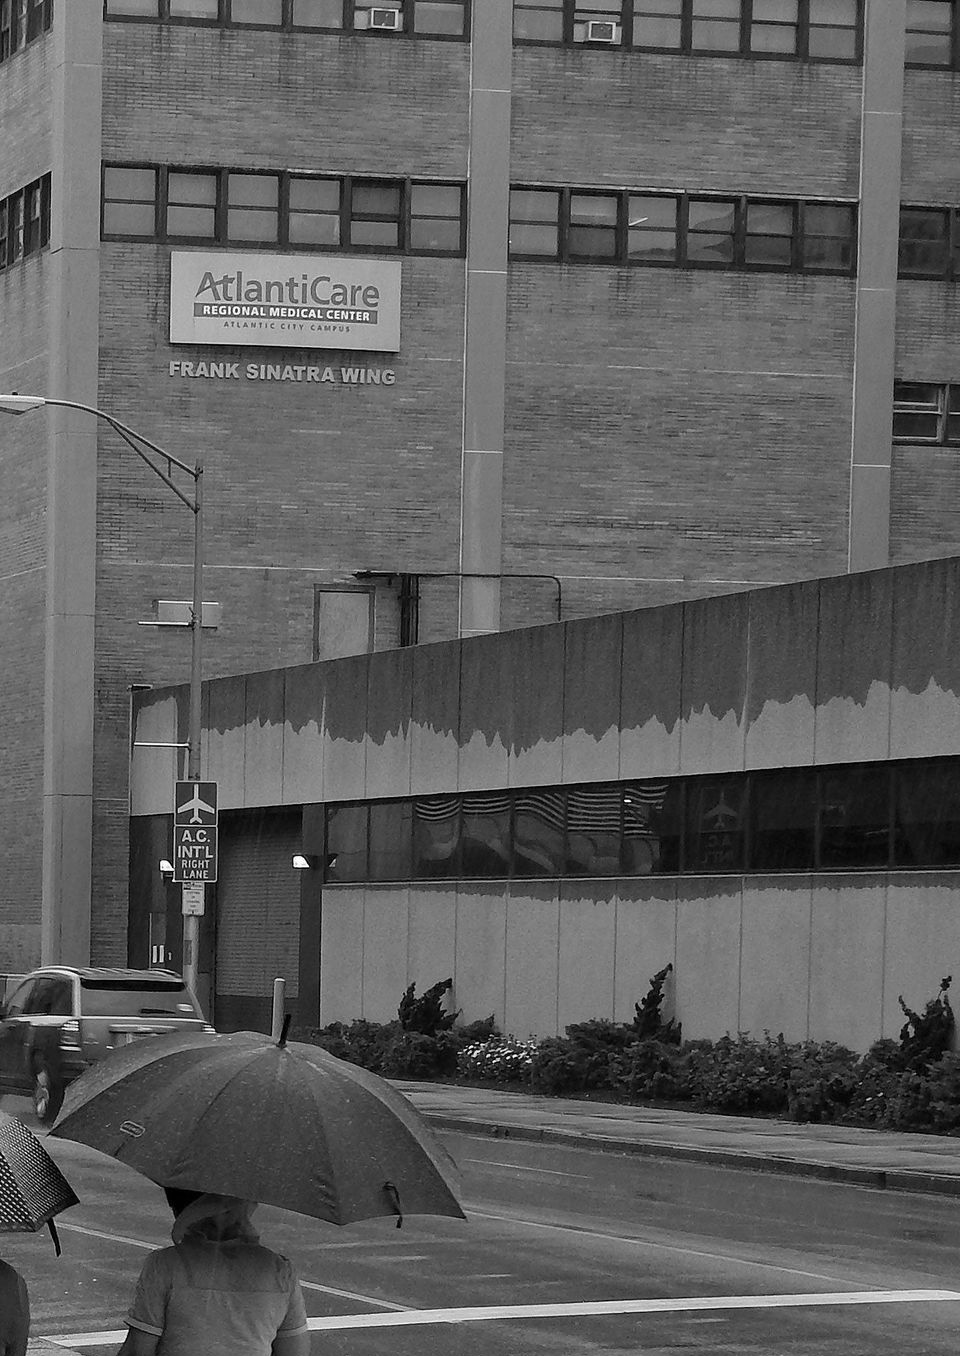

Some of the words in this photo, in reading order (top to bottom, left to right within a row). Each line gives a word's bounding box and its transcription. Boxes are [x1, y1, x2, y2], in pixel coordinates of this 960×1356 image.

[195, 271, 380, 307] AtlantiCare
[203, 305, 266, 317] REGIONAL
[269, 307, 323, 319] MEDICAL
[326, 310, 370, 321] CENTER
[223, 321, 275, 330] ATLANTIC
[280, 323, 304, 331] CITY
[310, 324, 351, 333] CAMPUS
[168, 360, 240, 379] FRANK
[246, 363, 335, 383] SINATRA
[340, 367, 396, 385] WING
[182, 829, 210, 842] A.C.
[178, 845, 213, 858] INT'L
[182, 860, 210, 868] RIGHT
[183, 870, 209, 879] LANE
